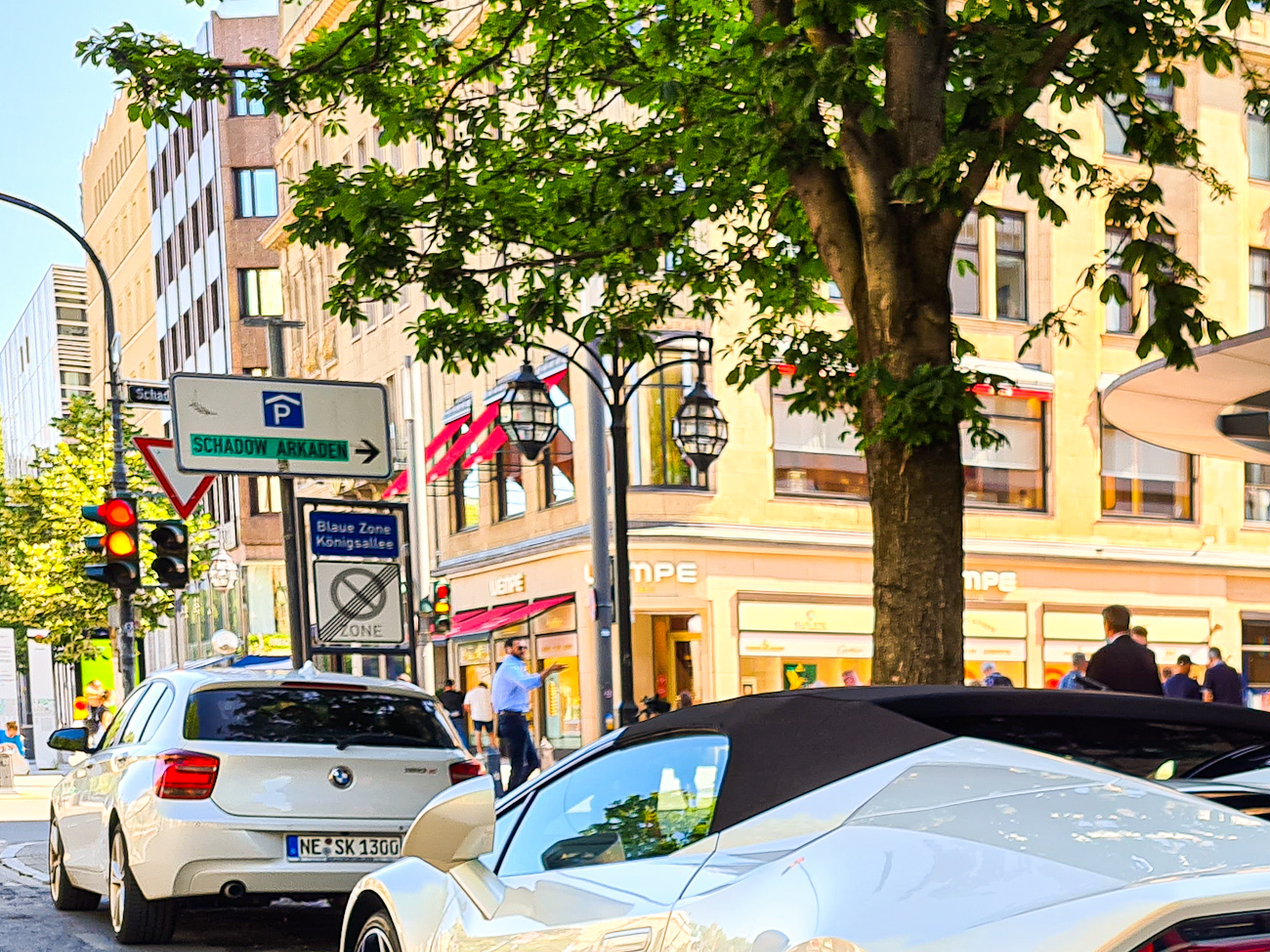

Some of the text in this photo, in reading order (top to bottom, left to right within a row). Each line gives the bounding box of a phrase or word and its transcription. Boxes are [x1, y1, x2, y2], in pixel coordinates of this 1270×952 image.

[136, 388, 169, 402] Schad
[192, 435, 348, 460] SCHADOW ARKADEN
[316, 520, 392, 535] Blaue Zone
[315, 535, 394, 550] Königsallee
[584, 561, 698, 585] MPE
[340, 624, 384, 638] ZONE
[300, 839, 399, 856] NE SK 1300
